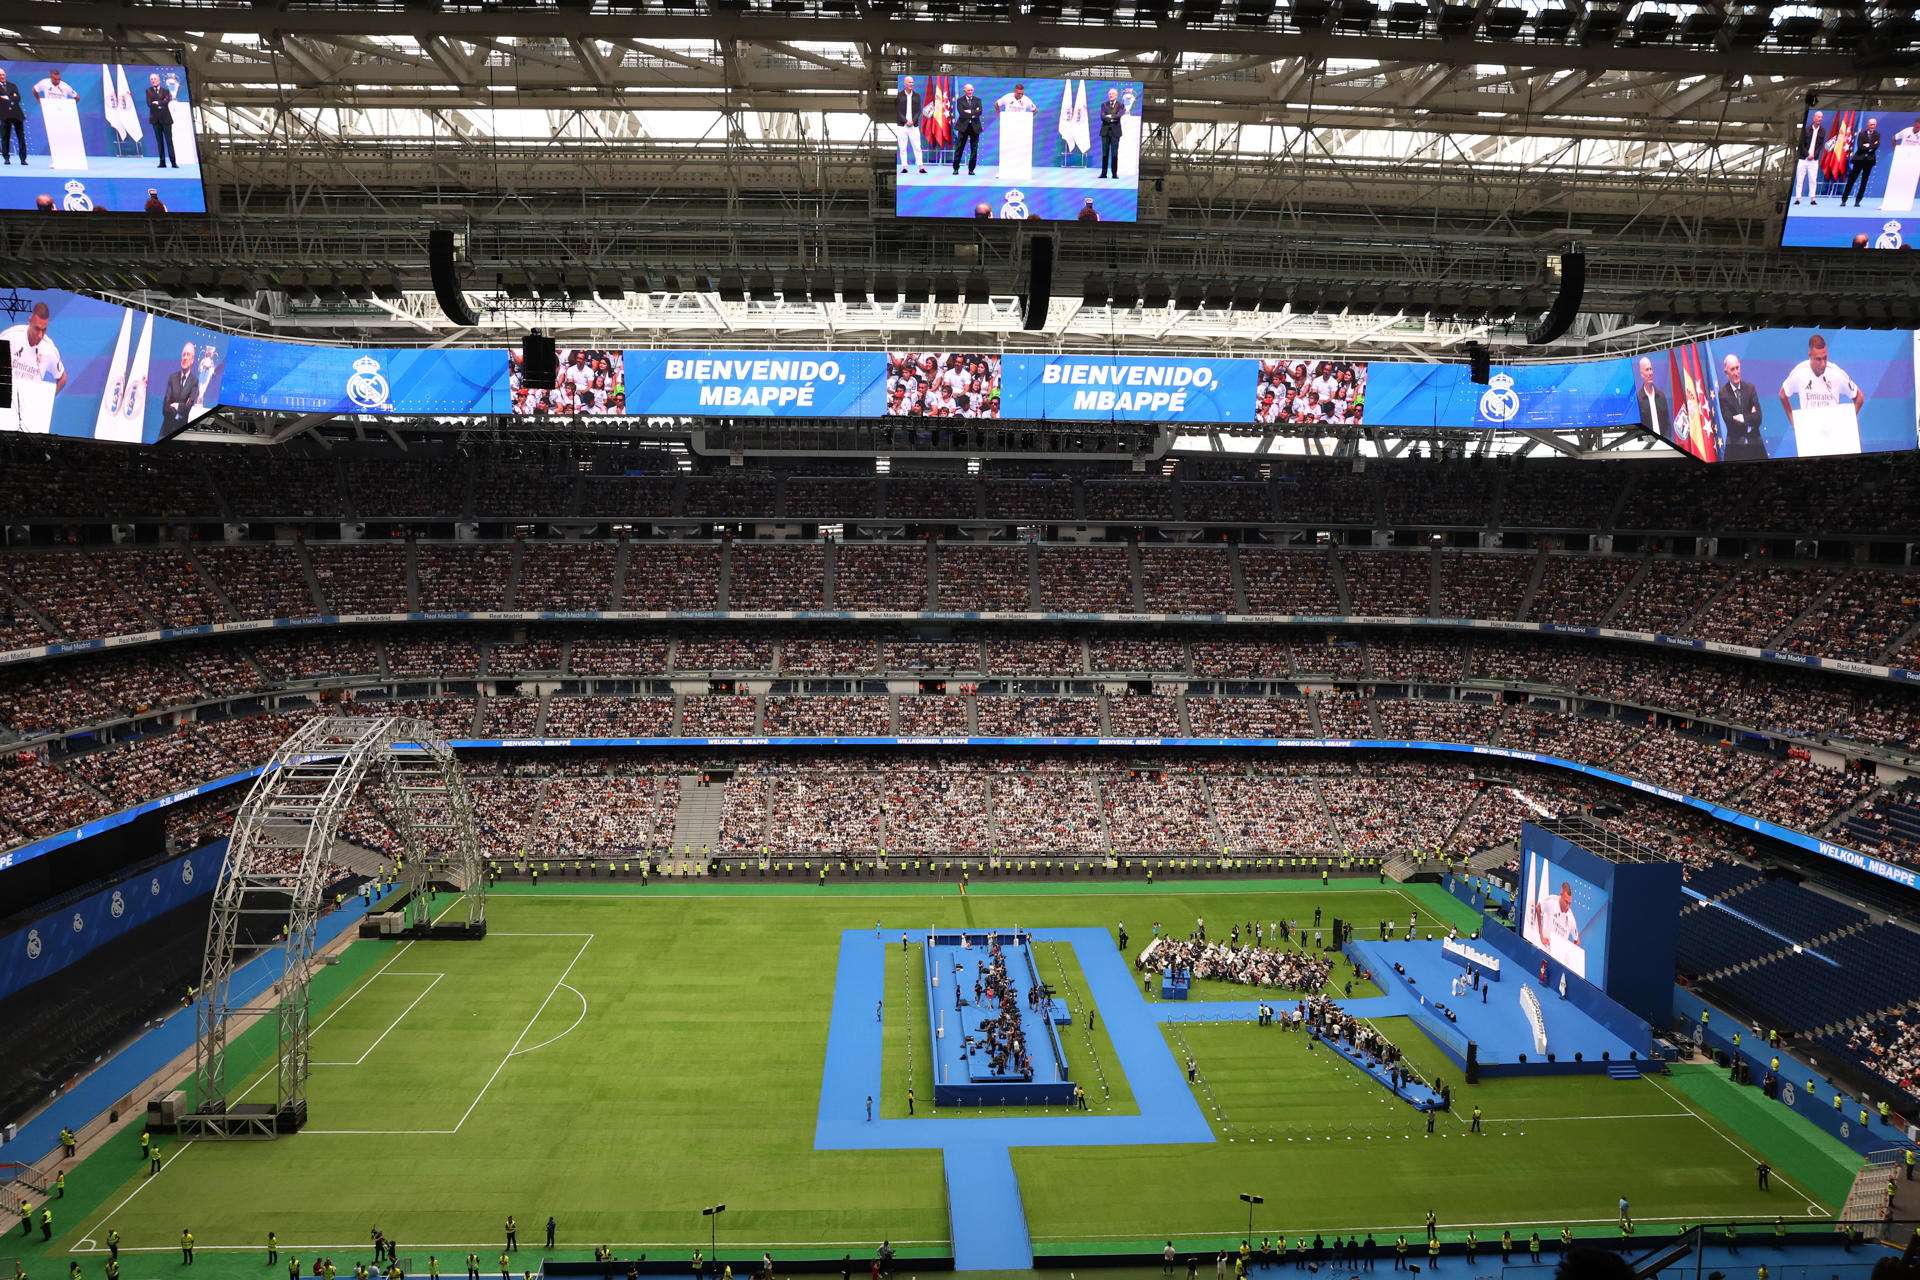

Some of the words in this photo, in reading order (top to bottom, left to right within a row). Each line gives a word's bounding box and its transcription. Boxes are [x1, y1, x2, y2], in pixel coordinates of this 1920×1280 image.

[665, 360, 846, 385] BIENVENIDO,
[1042, 364, 1218, 392] BIENVENIDO,
[699, 382, 815, 407] MBAPPÉ
[1073, 387, 1187, 412] MBAPPÉ
[11, 650, 30, 660] Madrid
[1836, 662, 1850, 670] Real
[1852, 664, 1872, 674] Madrid
[1906, 672, 1920, 680] Real
[1474, 746, 1510, 757] BEM-VINDO,
[1819, 842, 1866, 870] WELKOM,
